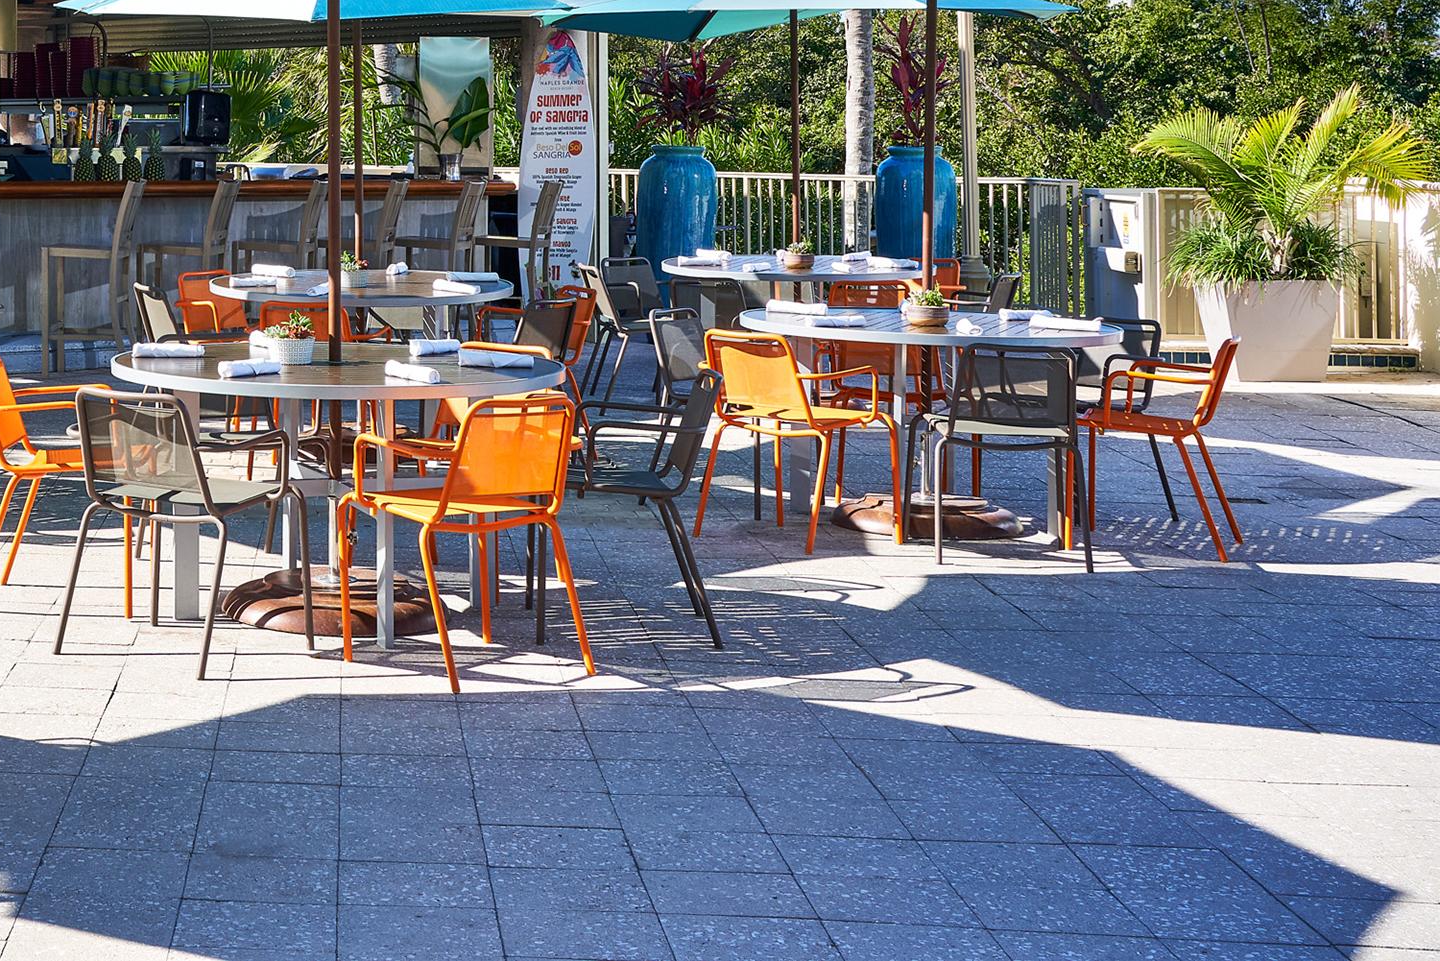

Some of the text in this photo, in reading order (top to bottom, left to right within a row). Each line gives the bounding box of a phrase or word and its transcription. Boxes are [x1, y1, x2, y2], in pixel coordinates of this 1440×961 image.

[556, 143, 568, 151] Del
[569, 143, 581, 152] Sol
[533, 151, 571, 159] SANGRIA
